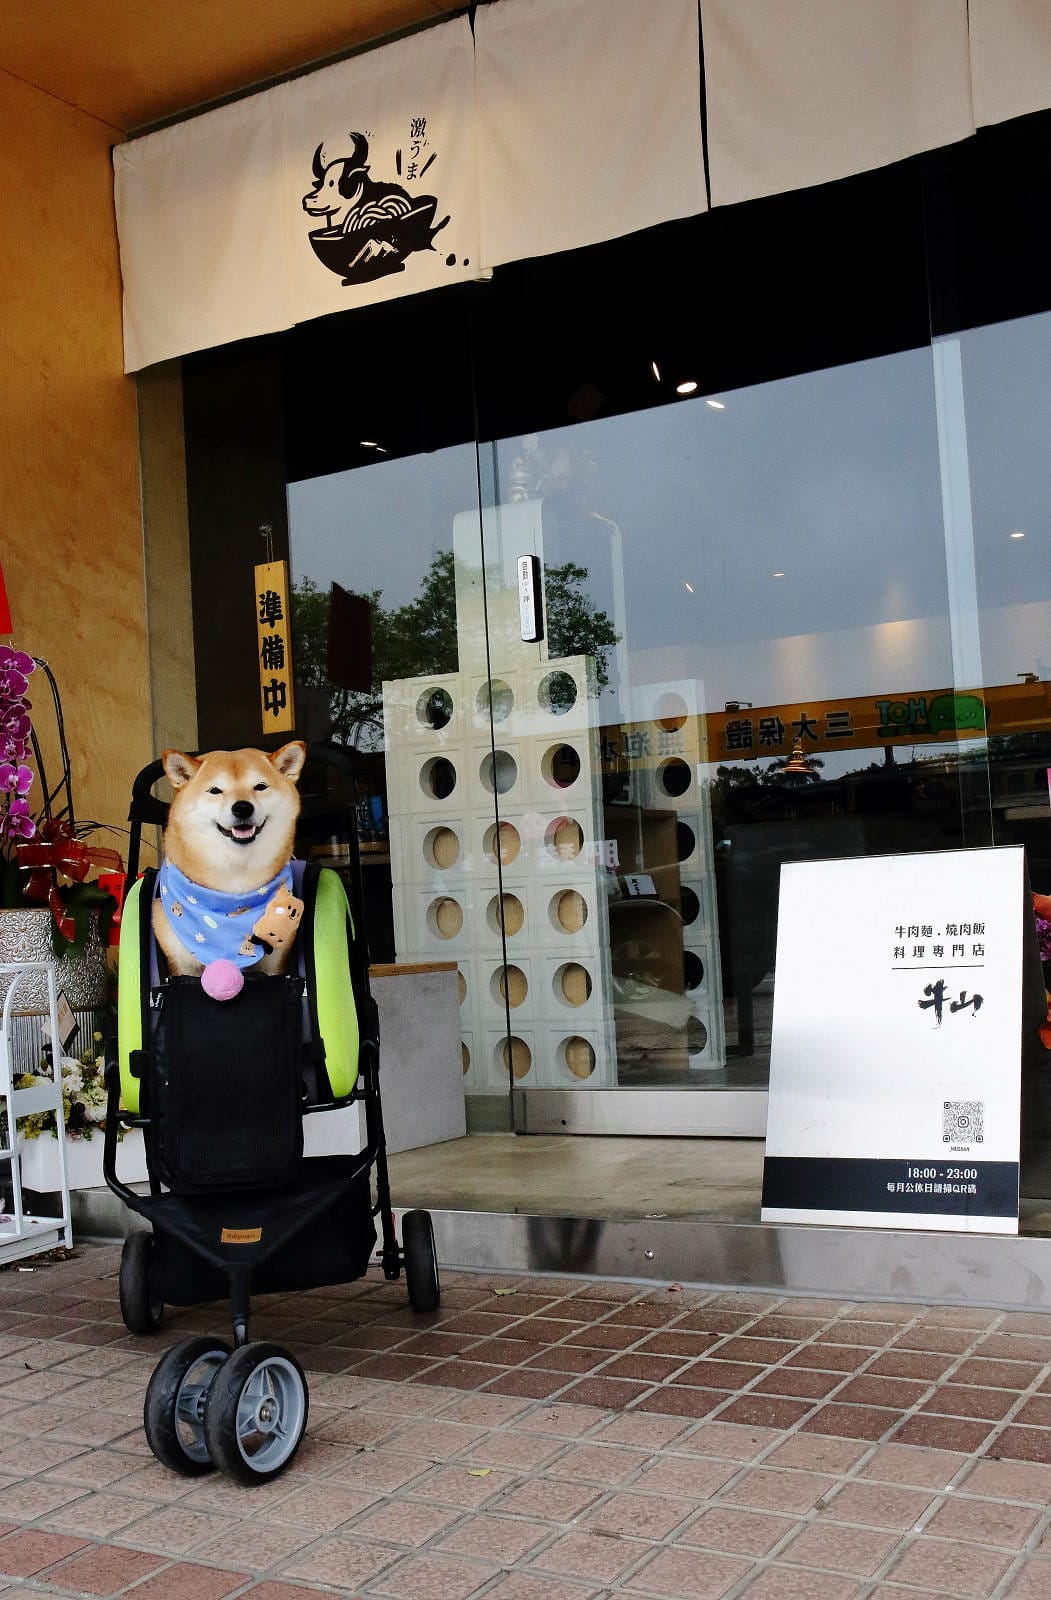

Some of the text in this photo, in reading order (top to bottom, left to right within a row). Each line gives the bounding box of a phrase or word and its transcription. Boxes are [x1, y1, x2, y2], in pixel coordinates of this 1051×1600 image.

[259, 590, 287, 717] 準備中
[893, 943, 985, 959] 料理專門店
[918, 979, 984, 1028] 牛山
[908, 1168, 936, 1178] 18:00
[946, 1168, 977, 1179] 23:00
